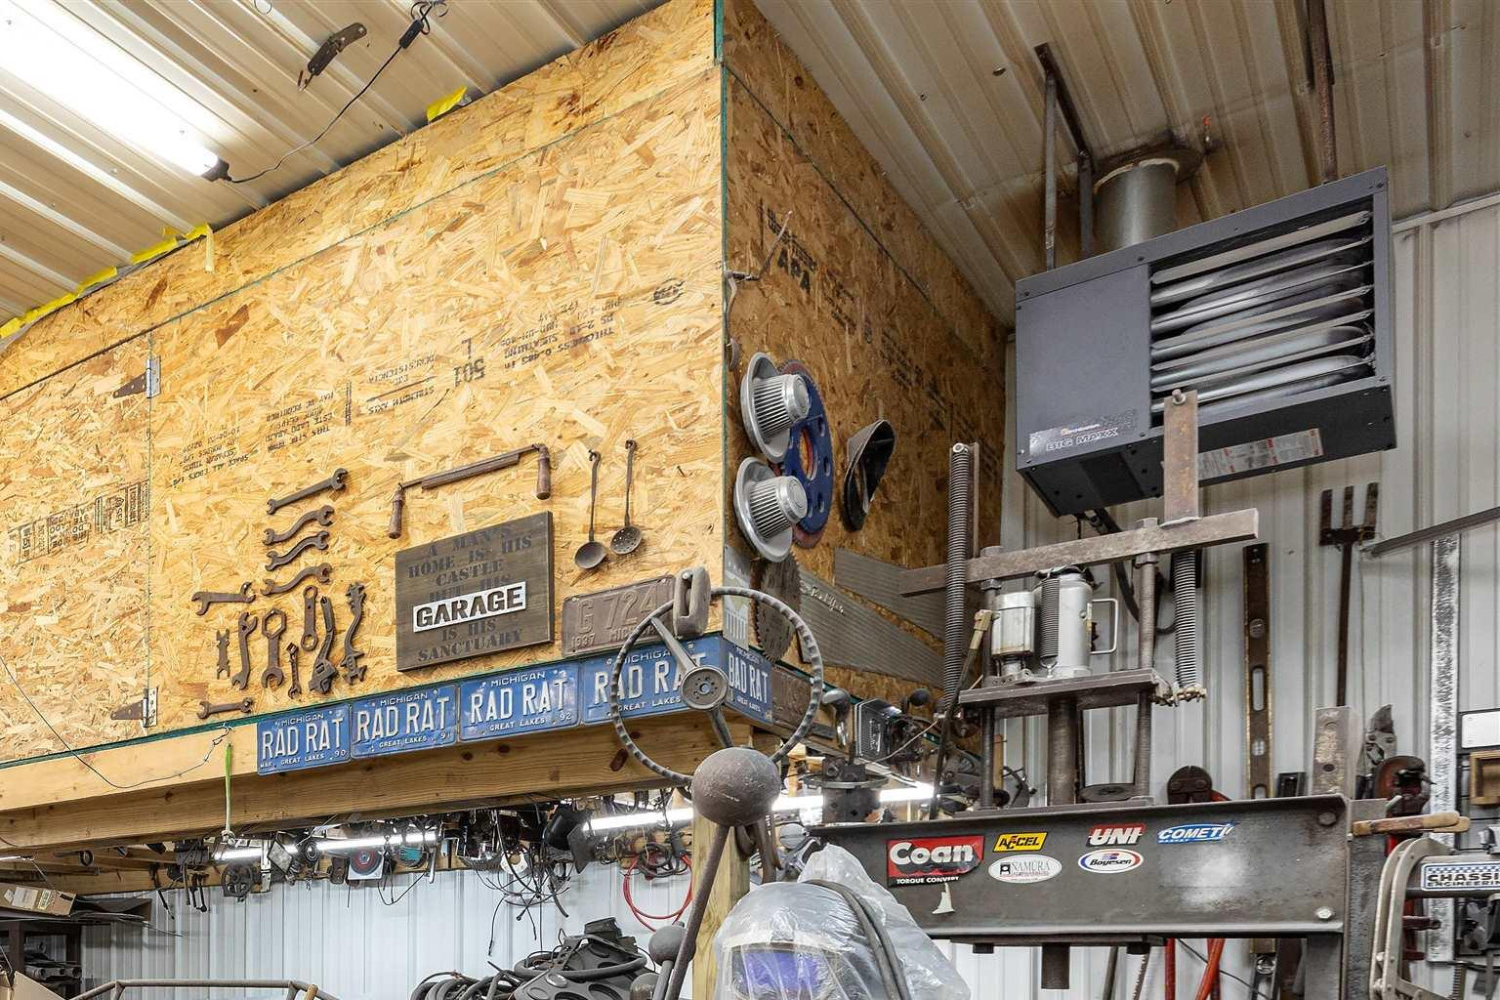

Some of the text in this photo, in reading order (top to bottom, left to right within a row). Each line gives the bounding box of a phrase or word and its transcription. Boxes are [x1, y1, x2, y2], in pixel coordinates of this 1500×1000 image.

[1046, 438, 1073, 452] BIG
[1075, 426, 1119, 446] MAXX
[408, 535, 532, 578] HOME IS HIS
[435, 559, 504, 586] CASTLE
[416, 586, 523, 627] GARAGE
[442, 619, 497, 640] IS HIS
[418, 629, 522, 662] SANCTUARY
[572, 633, 595, 649] 1937
[490, 671, 546, 687] MICHIGAN
[728, 652, 747, 694] BAD
[749, 665, 768, 703] RAT
[380, 692, 428, 706] MICHIGAN
[470, 679, 568, 724] RAD RAT
[652, 696, 681, 707] LAKES
[282, 713, 324, 727] MICHIGAN
[357, 697, 450, 742] RAD RAT
[489, 712, 572, 731] GREAT LAKES 92
[262, 718, 344, 760] RAD RAT
[379, 739, 401, 748] GREAT
[404, 735, 428, 744] LAKES
[281, 757, 301, 766] GREAT
[304, 753, 325, 762] LAKES
[1090, 827, 1143, 846] UNI
[889, 842, 974, 865] Coan
[1090, 858, 1132, 866] Boyesen
[1012, 860, 1050, 872] NAMURA
